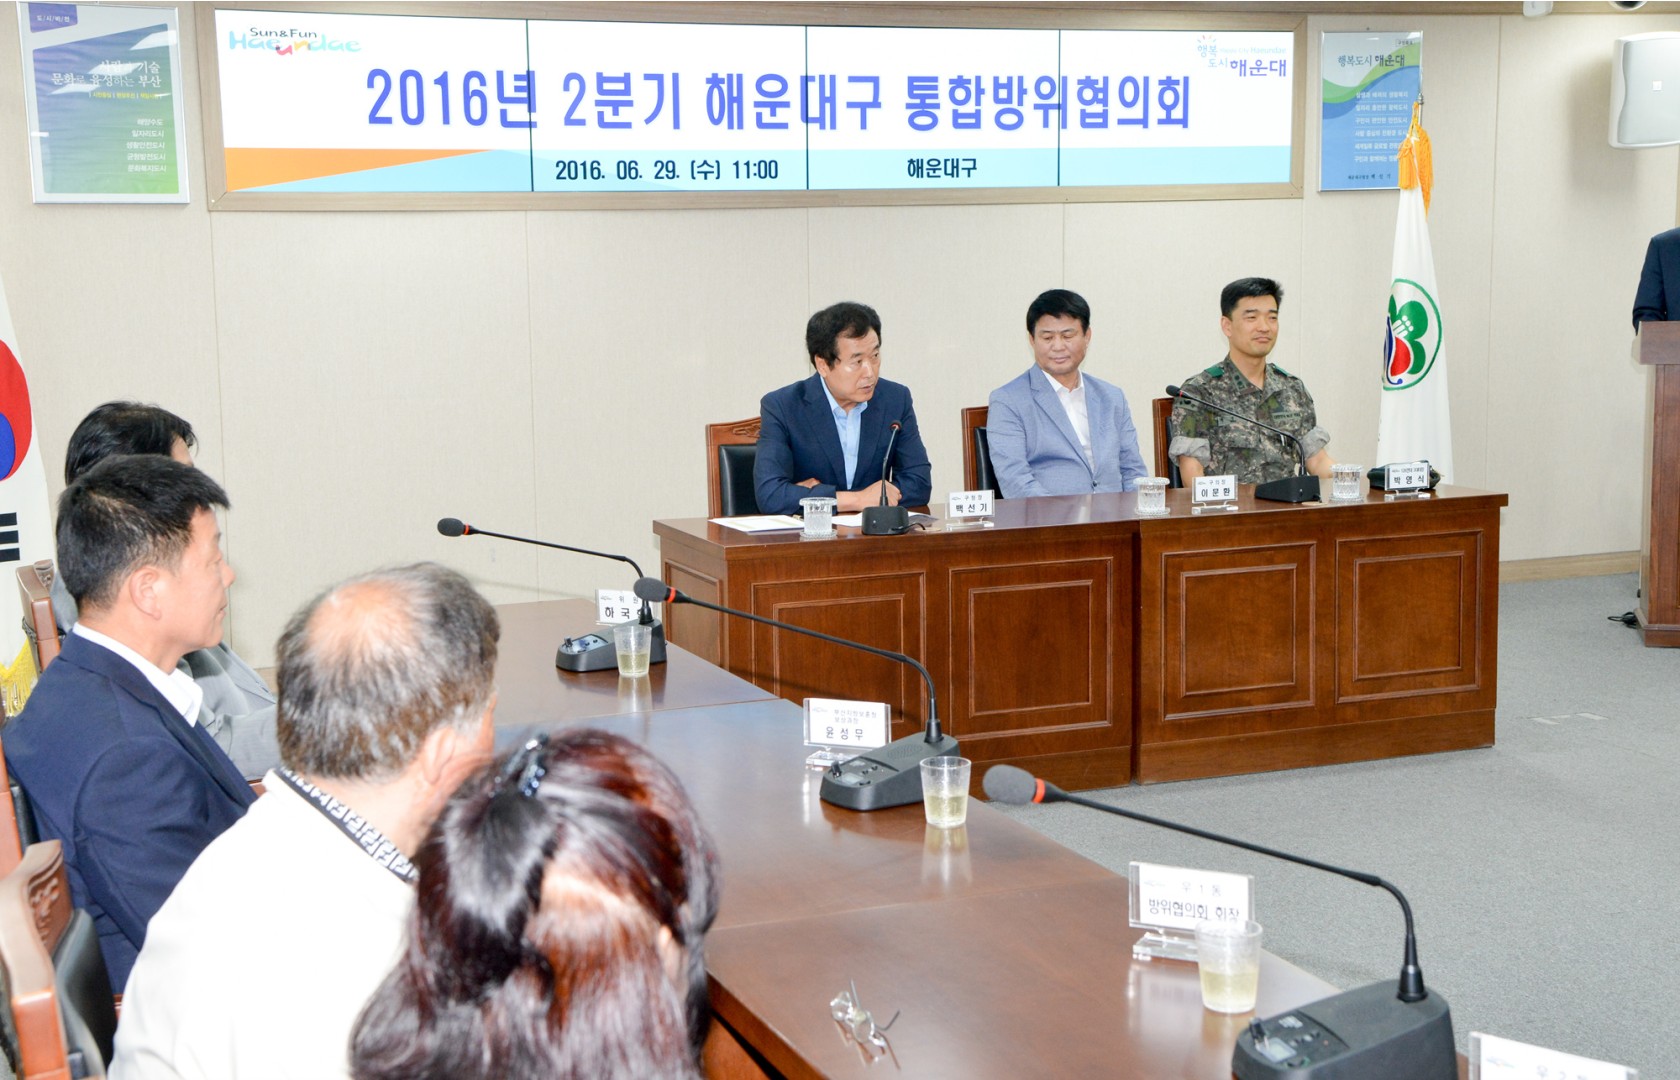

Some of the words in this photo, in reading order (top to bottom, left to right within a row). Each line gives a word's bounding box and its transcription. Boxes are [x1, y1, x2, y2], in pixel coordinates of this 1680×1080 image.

[250, 27, 317, 38] Sun&Fun
[229, 31, 361, 56] Haeundae
[1197, 44, 1217, 58] 행복
[138, 61, 161, 74] 기술
[1208, 58, 1228, 68] 도시
[1230, 59, 1286, 77] 해운대
[1338, 54, 1372, 67] 행복도시
[1374, 54, 1405, 67] 해운대
[138, 75, 162, 88] 부산
[366, 68, 538, 129] 2016년
[563, 72, 681, 130] 2분기
[705, 72, 882, 131] 해운대구
[906, 75, 1191, 131] 통합방위협의회
[132, 130, 164, 138] 일자리도시
[555, 160, 605, 181] 2016.
[616, 160, 642, 181] 06.
[654, 160, 680, 181] 29.
[690, 159, 721, 181] (수)
[732, 160, 778, 180] 11:00
[907, 157, 978, 179] 해운대구
[1148, 898, 1208, 920] 방위협의회
